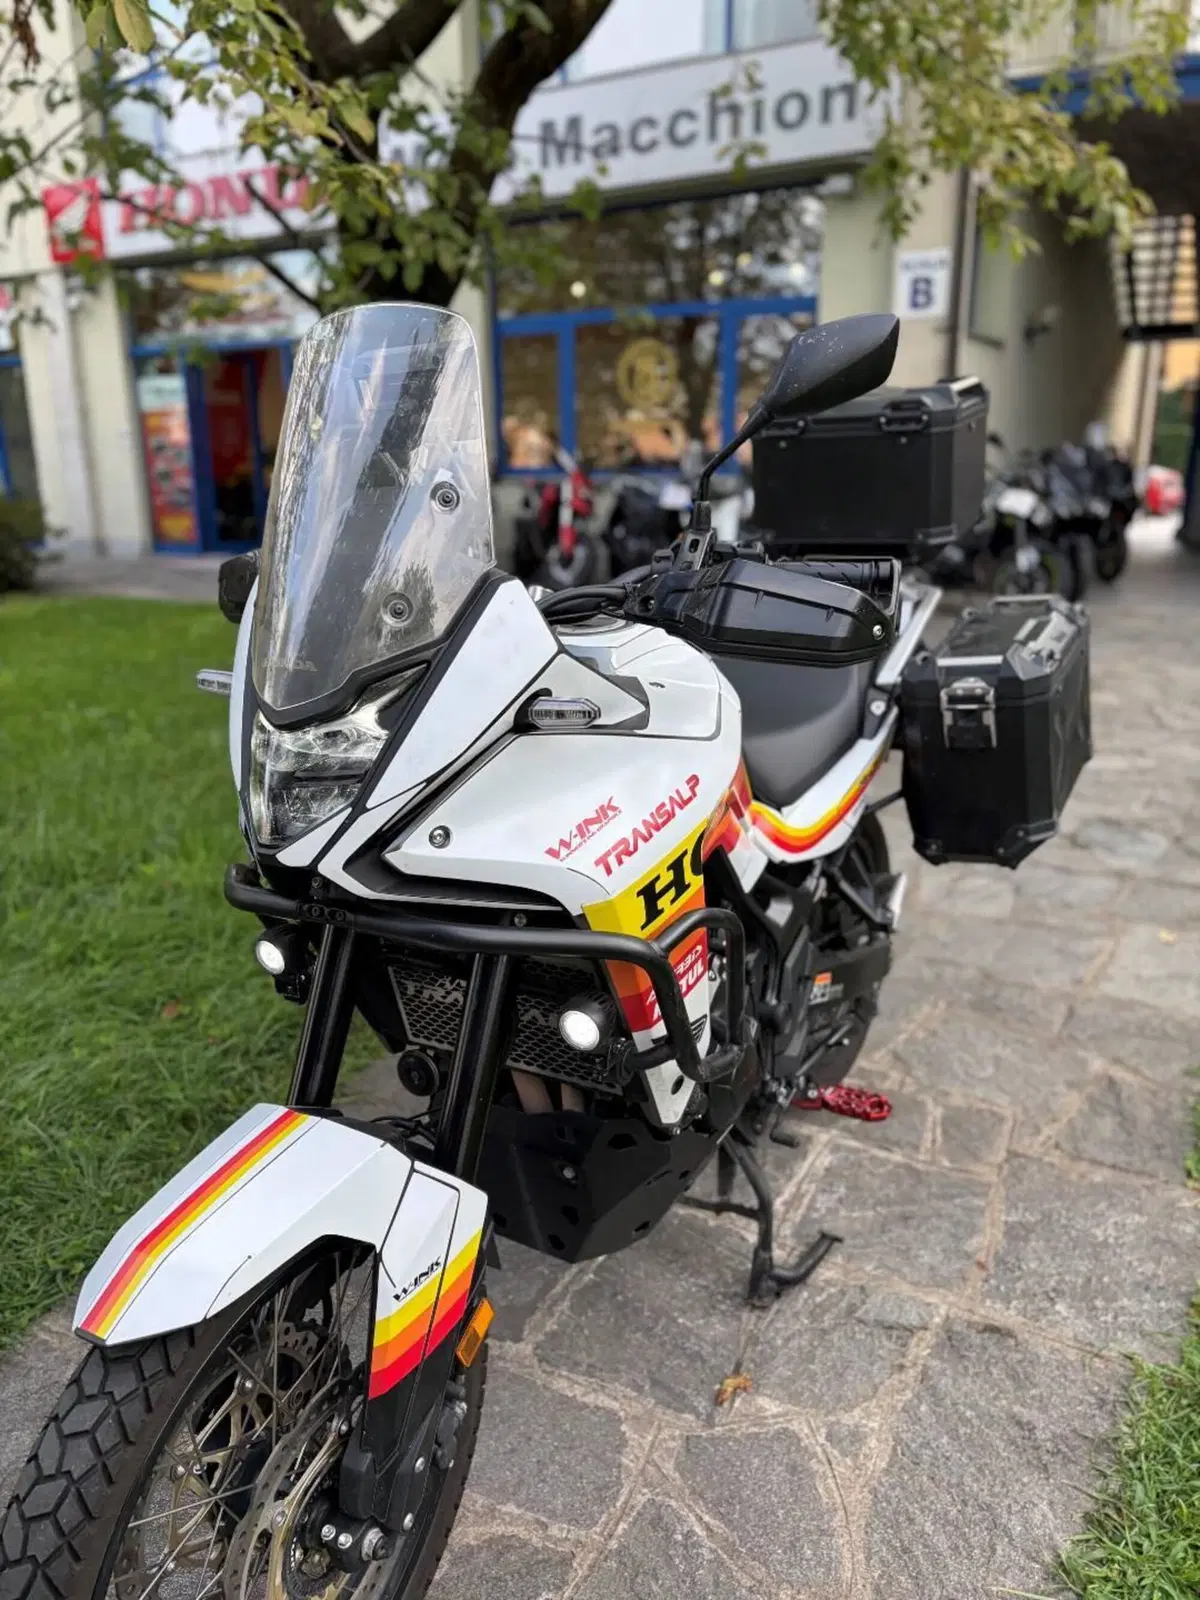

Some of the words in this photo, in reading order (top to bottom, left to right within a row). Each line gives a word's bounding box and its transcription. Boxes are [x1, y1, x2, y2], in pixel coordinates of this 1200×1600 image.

[118, 164, 312, 235] HOND
[909, 276, 934, 311] B
[594, 774, 700, 877] TRANSALP
